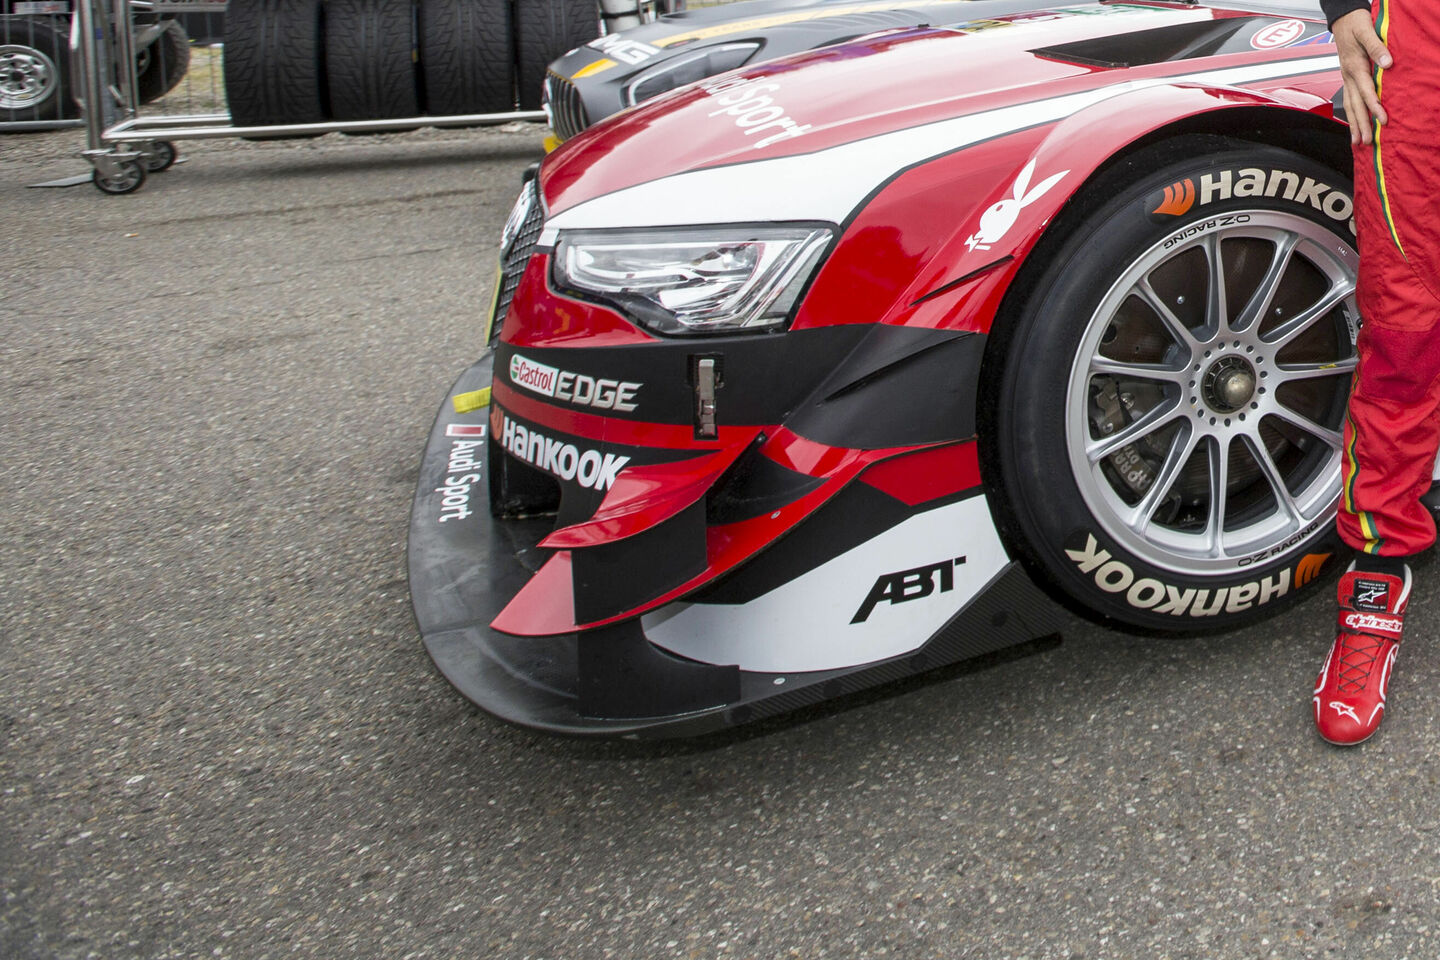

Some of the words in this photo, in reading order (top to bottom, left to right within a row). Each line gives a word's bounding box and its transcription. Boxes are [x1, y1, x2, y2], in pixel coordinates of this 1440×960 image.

[587, 32, 661, 65] MG
[708, 83, 812, 149] Sport
[1200, 168, 1358, 237] Hanko
[1163, 220, 1217, 250] RACING
[519, 361, 555, 392] Castrol
[554, 371, 644, 412] EDGE
[447, 440, 484, 474] Audi
[501, 416, 631, 491] Hankook
[435, 473, 482, 522] Sport
[1271, 521, 1319, 557] RACING
[849, 555, 967, 625] ABT
[1064, 533, 1291, 617] Hankook
